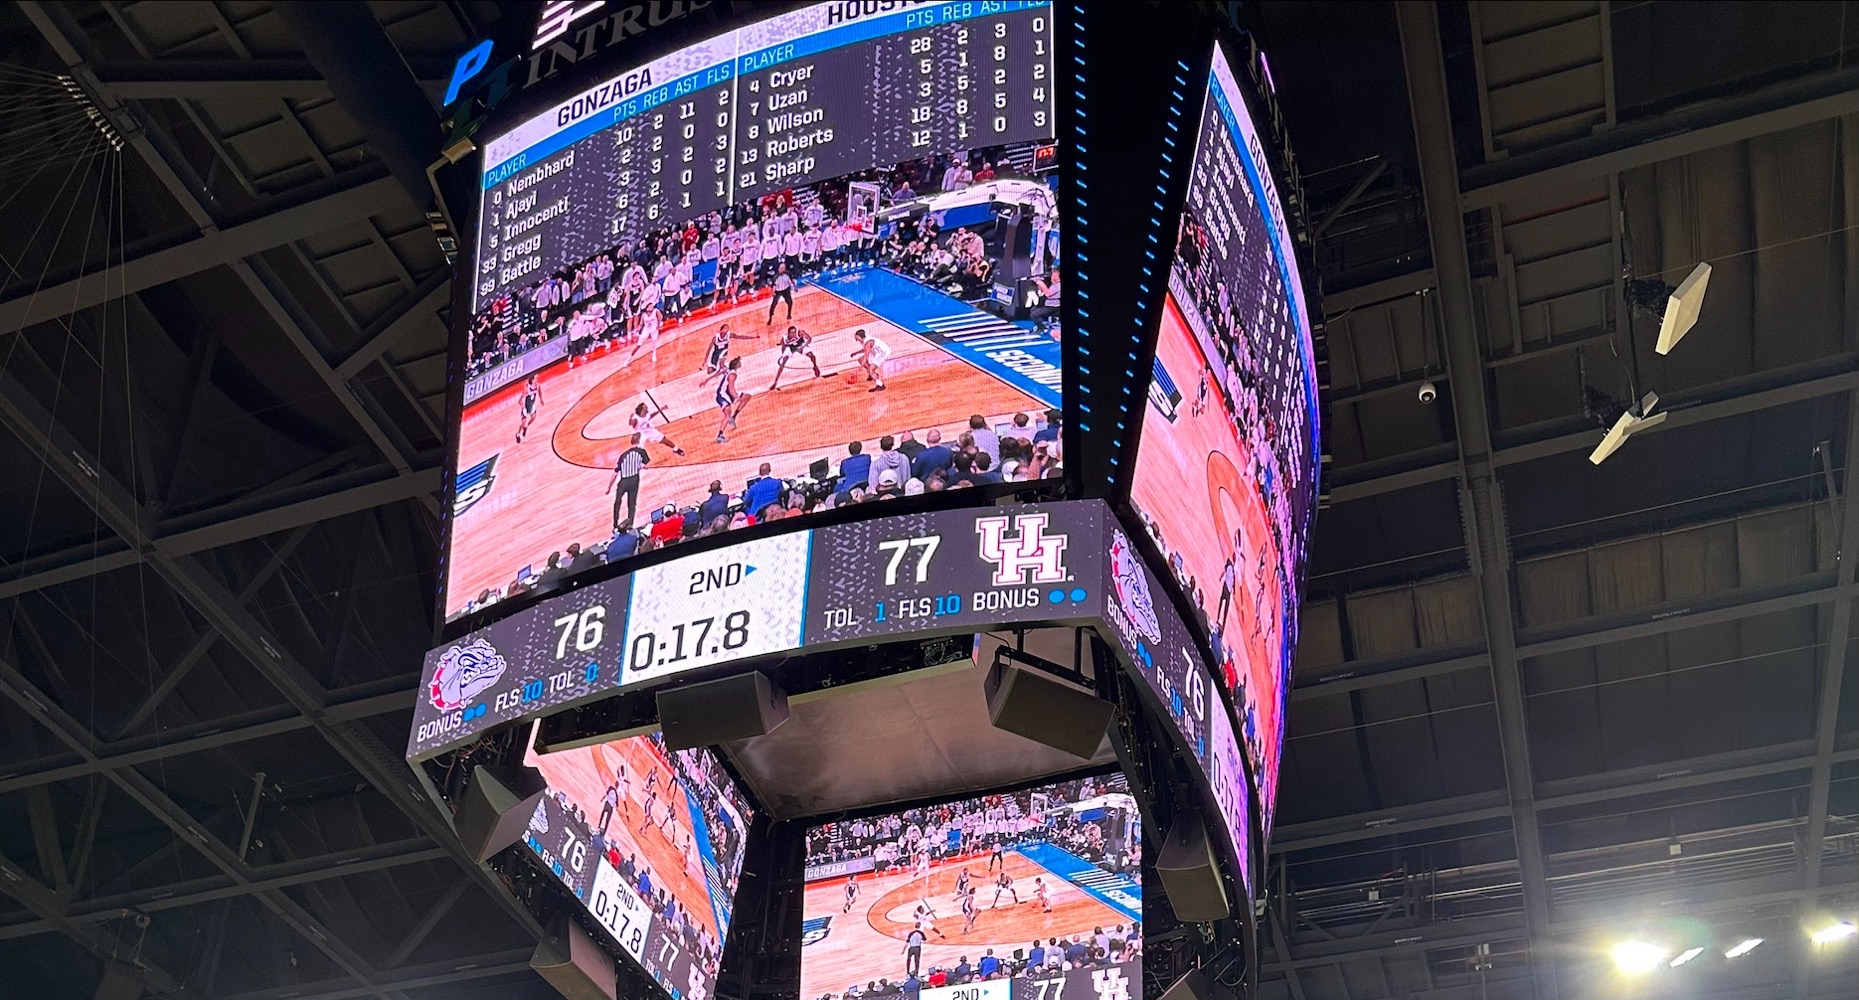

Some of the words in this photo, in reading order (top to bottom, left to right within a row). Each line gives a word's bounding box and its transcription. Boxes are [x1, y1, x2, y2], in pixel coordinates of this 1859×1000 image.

[744, 44, 794, 71] PLAYER
[906, 10, 934, 28] PTS
[943, 4, 972, 20] REB
[980, 1, 1007, 13] AST
[750, 80, 760, 93] 4
[770, 65, 814, 88] Cryer
[910, 37, 931, 55] 28
[957, 29, 968, 45] 2
[994, 23, 1007, 38] 3
[1032, 17, 1045, 33] 0
[558, 68, 652, 127] GONZAGA
[749, 125, 759, 139] 8
[767, 108, 824, 135] Wilson
[920, 82, 931, 98] 3
[957, 75, 969, 91] 5
[994, 69, 1006, 84] 2
[1034, 64, 1045, 80] 2
[751, 102, 760, 116] 7
[768, 89, 808, 112] Uzan
[920, 59, 931, 74] 5
[958, 52, 968, 67] 1
[994, 45, 1006, 61] 8
[1034, 40, 1045, 55] 1
[1211, 76, 1236, 131] PLAYER
[488, 153, 527, 186] PLAYER
[614, 100, 637, 121] PTS
[643, 87, 668, 108] REB
[675, 76, 699, 96] AST
[707, 65, 730, 84] FLS
[494, 191, 502, 205] 0
[508, 150, 575, 197] Nembhard
[616, 127, 632, 145] 10
[653, 114, 664, 130] 2
[680, 102, 695, 119] 11
[719, 90, 729, 106] 2
[740, 172, 757, 189] 21
[765, 156, 815, 181] Sharp
[912, 130, 931, 147] 12
[958, 123, 969, 138] 1
[994, 116, 1006, 132] 0
[1034, 111, 1046, 127] 3
[742, 149, 758, 165] 13
[767, 128, 834, 158] Roberts
[911, 106, 931, 124] 18
[956, 99, 968, 115] 8
[994, 93, 1007, 108] 5
[1032, 87, 1046, 103] 4
[490, 234, 498, 248] 5
[504, 196, 569, 241] Innocenti
[620, 171, 630, 186] 3
[651, 159, 662, 174] 3
[683, 147, 694, 162] 2
[716, 135, 728, 150] 3
[493, 214, 500, 227] 1
[506, 190, 538, 219] Ajayi
[621, 149, 631, 165] 2
[652, 136, 663, 151] 2
[684, 124, 695, 139] 0
[718, 112, 728, 127] 0
[1216, 146, 1235, 190] Ajayi
[1220, 124, 1255, 209] Nembhard
[1250, 132, 1285, 242] GONZAGA
[502, 255, 542, 285] Battle
[611, 216, 628, 235] 17
[649, 204, 659, 220] 6
[682, 192, 691, 208] 1
[716, 181, 725, 197] 1
[503, 234, 542, 262] Gregg
[618, 193, 629, 209] 6
[650, 181, 660, 197] 2
[682, 170, 693, 185] 0
[715, 158, 726, 174] 2
[1205, 206, 1229, 261] Battle
[1209, 186, 1231, 242] Gregg
[1212, 164, 1246, 245] Innocenti
[466, 359, 524, 400] GONZAGA
[689, 563, 742, 595] 2ND
[878, 535, 941, 586] 77
[975, 512, 1068, 587] UH
[554, 605, 607, 660] 76
[630, 610, 751, 672] 0:17.8
[824, 607, 857, 629] TOL
[875, 602, 886, 622] 1
[898, 597, 932, 619] FLS
[935, 594, 962, 616] 10
[973, 588, 1040, 612] BONUS
[1107, 594, 1138, 651] BONUS
[1157, 665, 1171, 699] FLS
[1182, 646, 1205, 722] 76
[416, 711, 463, 743] BONUS
[494, 688, 520, 713] FLS
[522, 679, 545, 703] 10
[549, 670, 575, 693] TOL
[586, 662, 598, 684] 0
[561, 826, 587, 873] 76
[595, 890, 642, 955] 0:17.8
[616, 883, 635, 911] 2ND
[658, 932, 680, 972] 77
